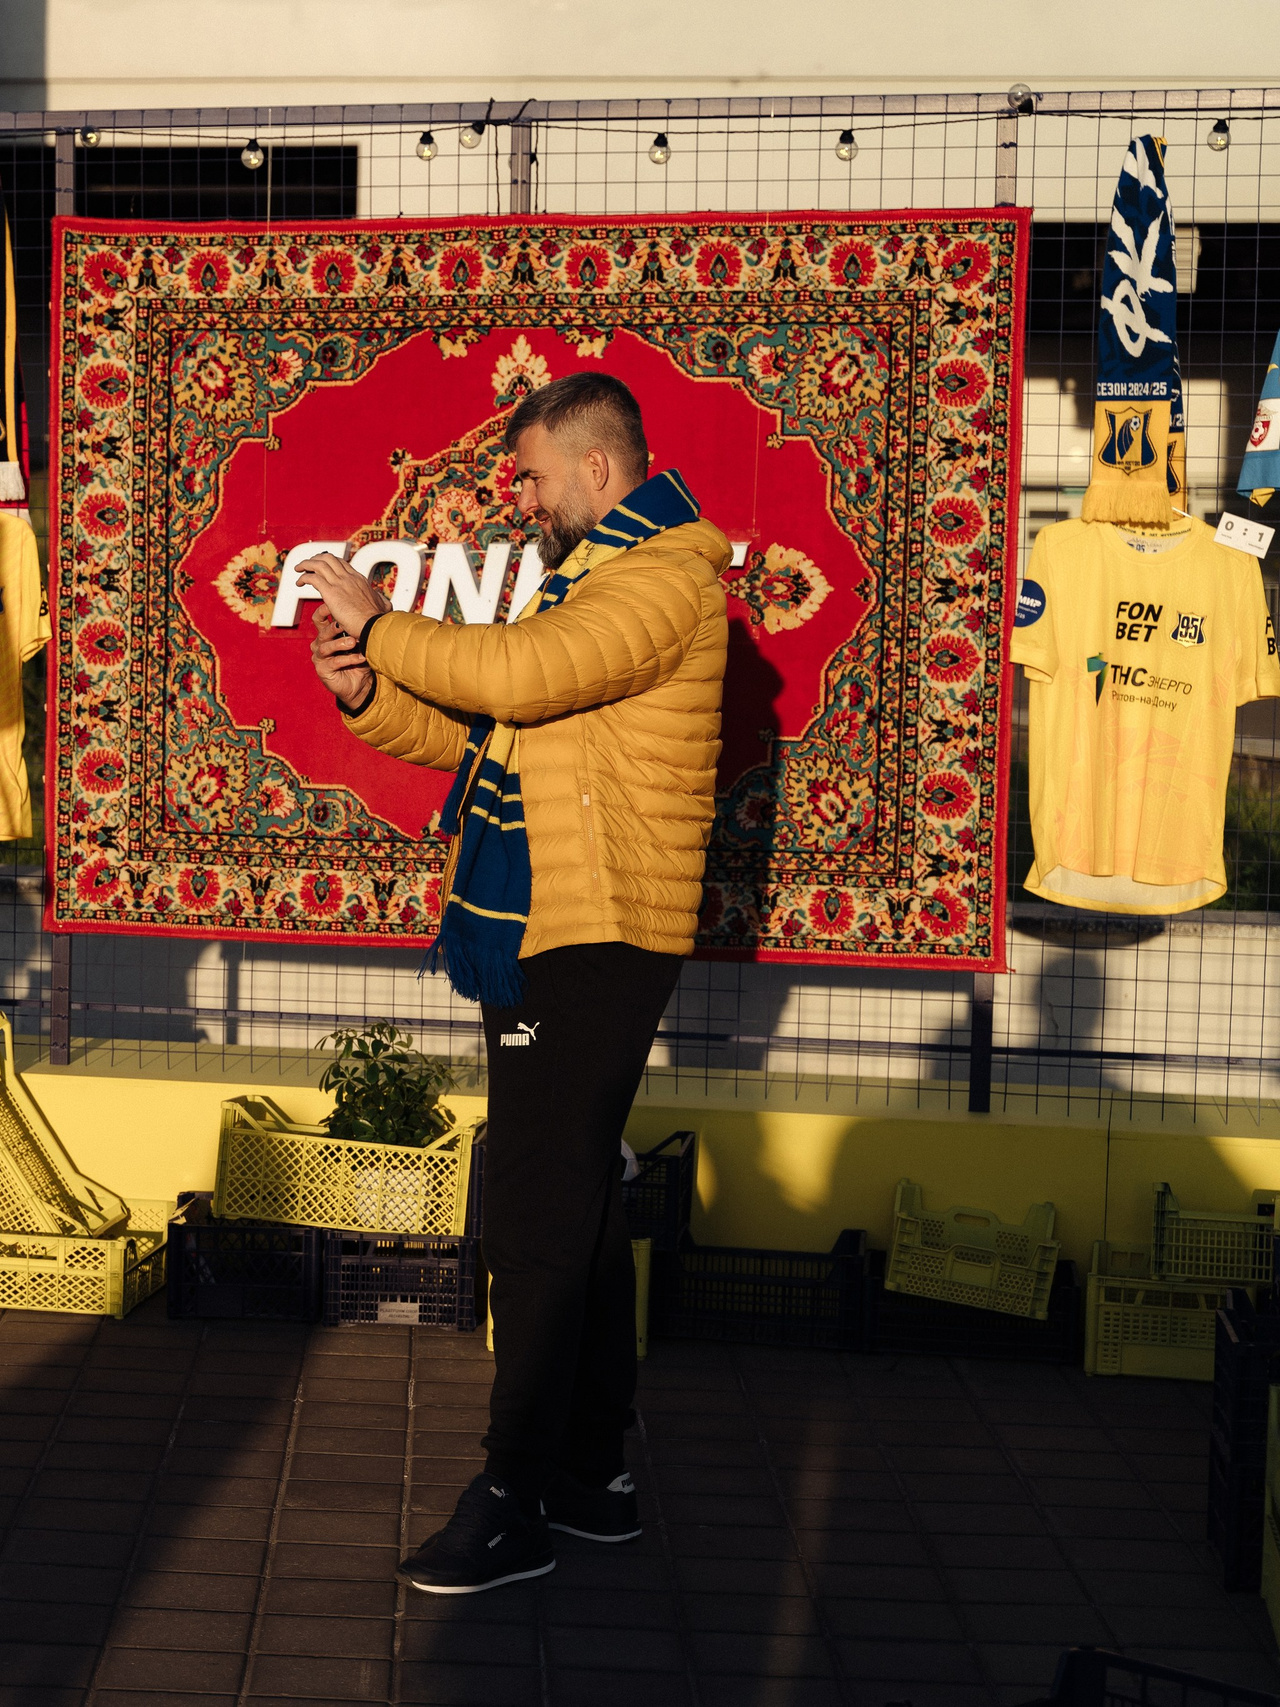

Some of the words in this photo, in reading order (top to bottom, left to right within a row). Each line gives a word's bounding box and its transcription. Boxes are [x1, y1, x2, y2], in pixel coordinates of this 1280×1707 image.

[1224, 520, 1234, 531] 0
[1258, 532, 1265, 542] 1
[1116, 601, 1163, 622] FON
[1116, 622, 1158, 642] BET
[1111, 664, 1149, 688] ТНС
[1147, 674, 1194, 695] ЭНЕРГО
[500, 1033, 530, 1047] PUMA
